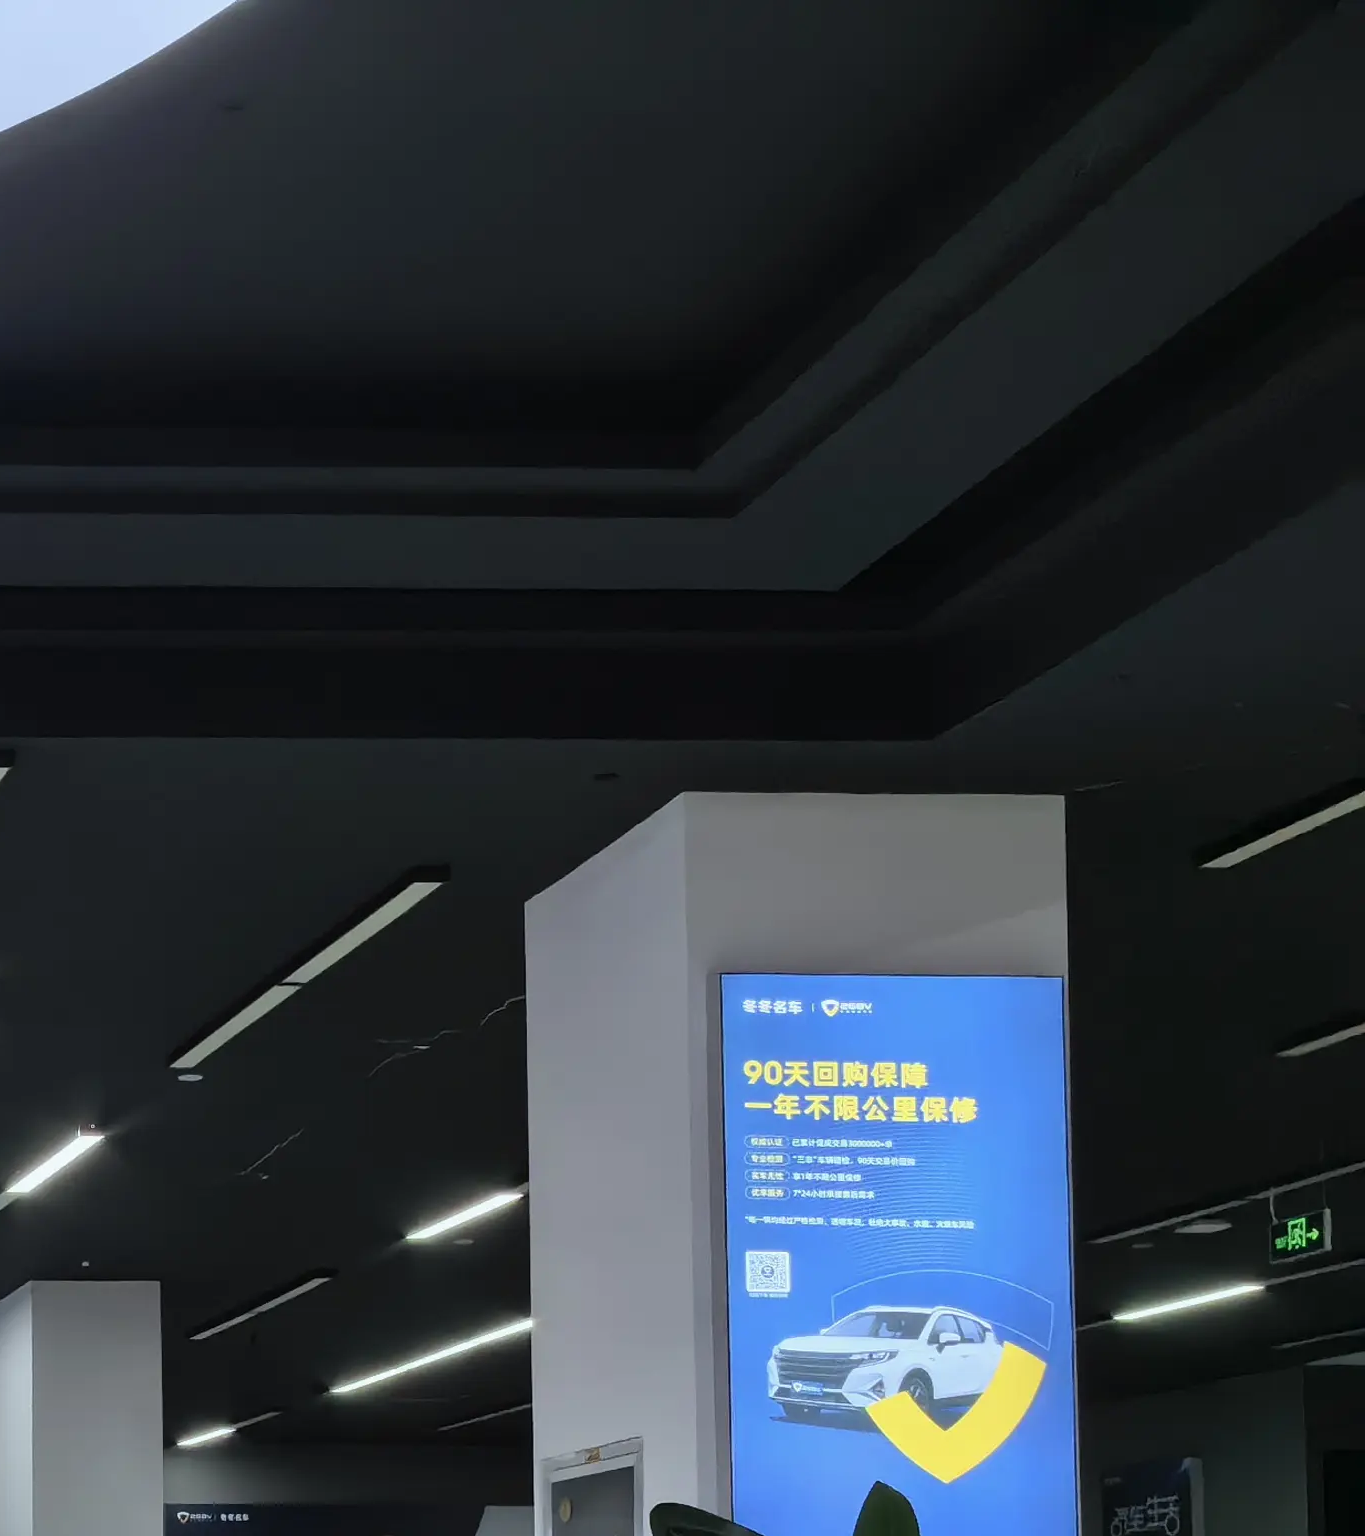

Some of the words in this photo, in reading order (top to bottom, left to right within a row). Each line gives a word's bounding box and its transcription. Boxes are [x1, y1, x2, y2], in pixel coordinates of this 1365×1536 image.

[742, 999, 803, 1014] 冬冬名车
[744, 1060, 929, 1088] 90天回购保障
[744, 1094, 979, 1123] 一年不限公里保修
